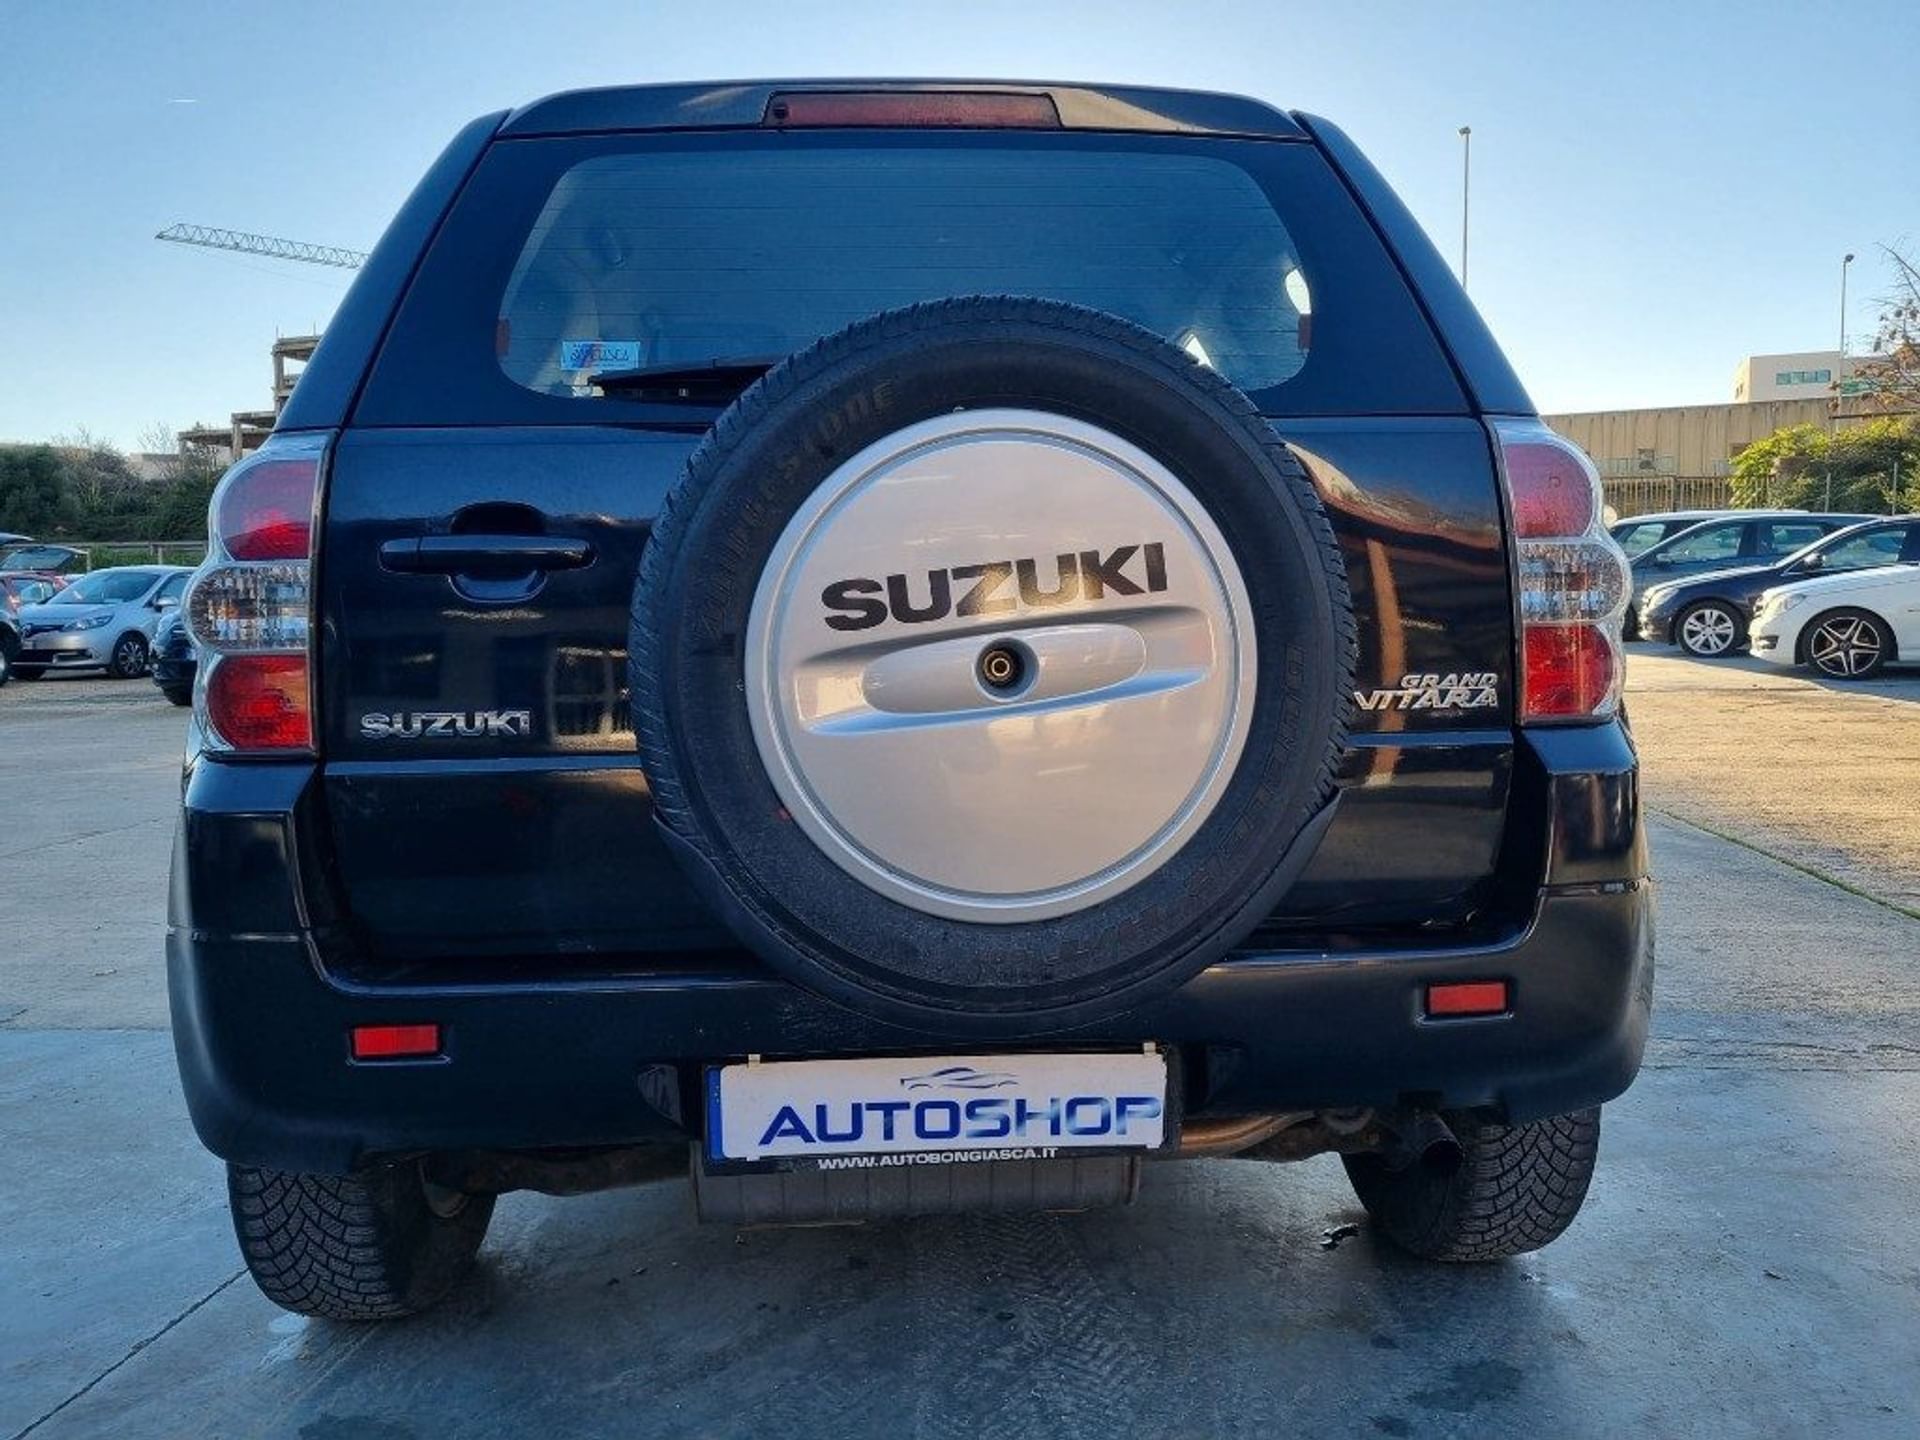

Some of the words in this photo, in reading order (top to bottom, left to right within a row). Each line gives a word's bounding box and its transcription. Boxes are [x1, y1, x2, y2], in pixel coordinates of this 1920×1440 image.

[821, 542, 1168, 631] SUZUKI
[1400, 672, 1499, 689] GRAND
[1352, 687, 1499, 710] VITARA
[360, 710, 531, 738] SUZUKI
[758, 1096, 1163, 1145] AUTOSHOP
[817, 1147, 1059, 1170] WWW.AUTOBONGIASCA.IT
